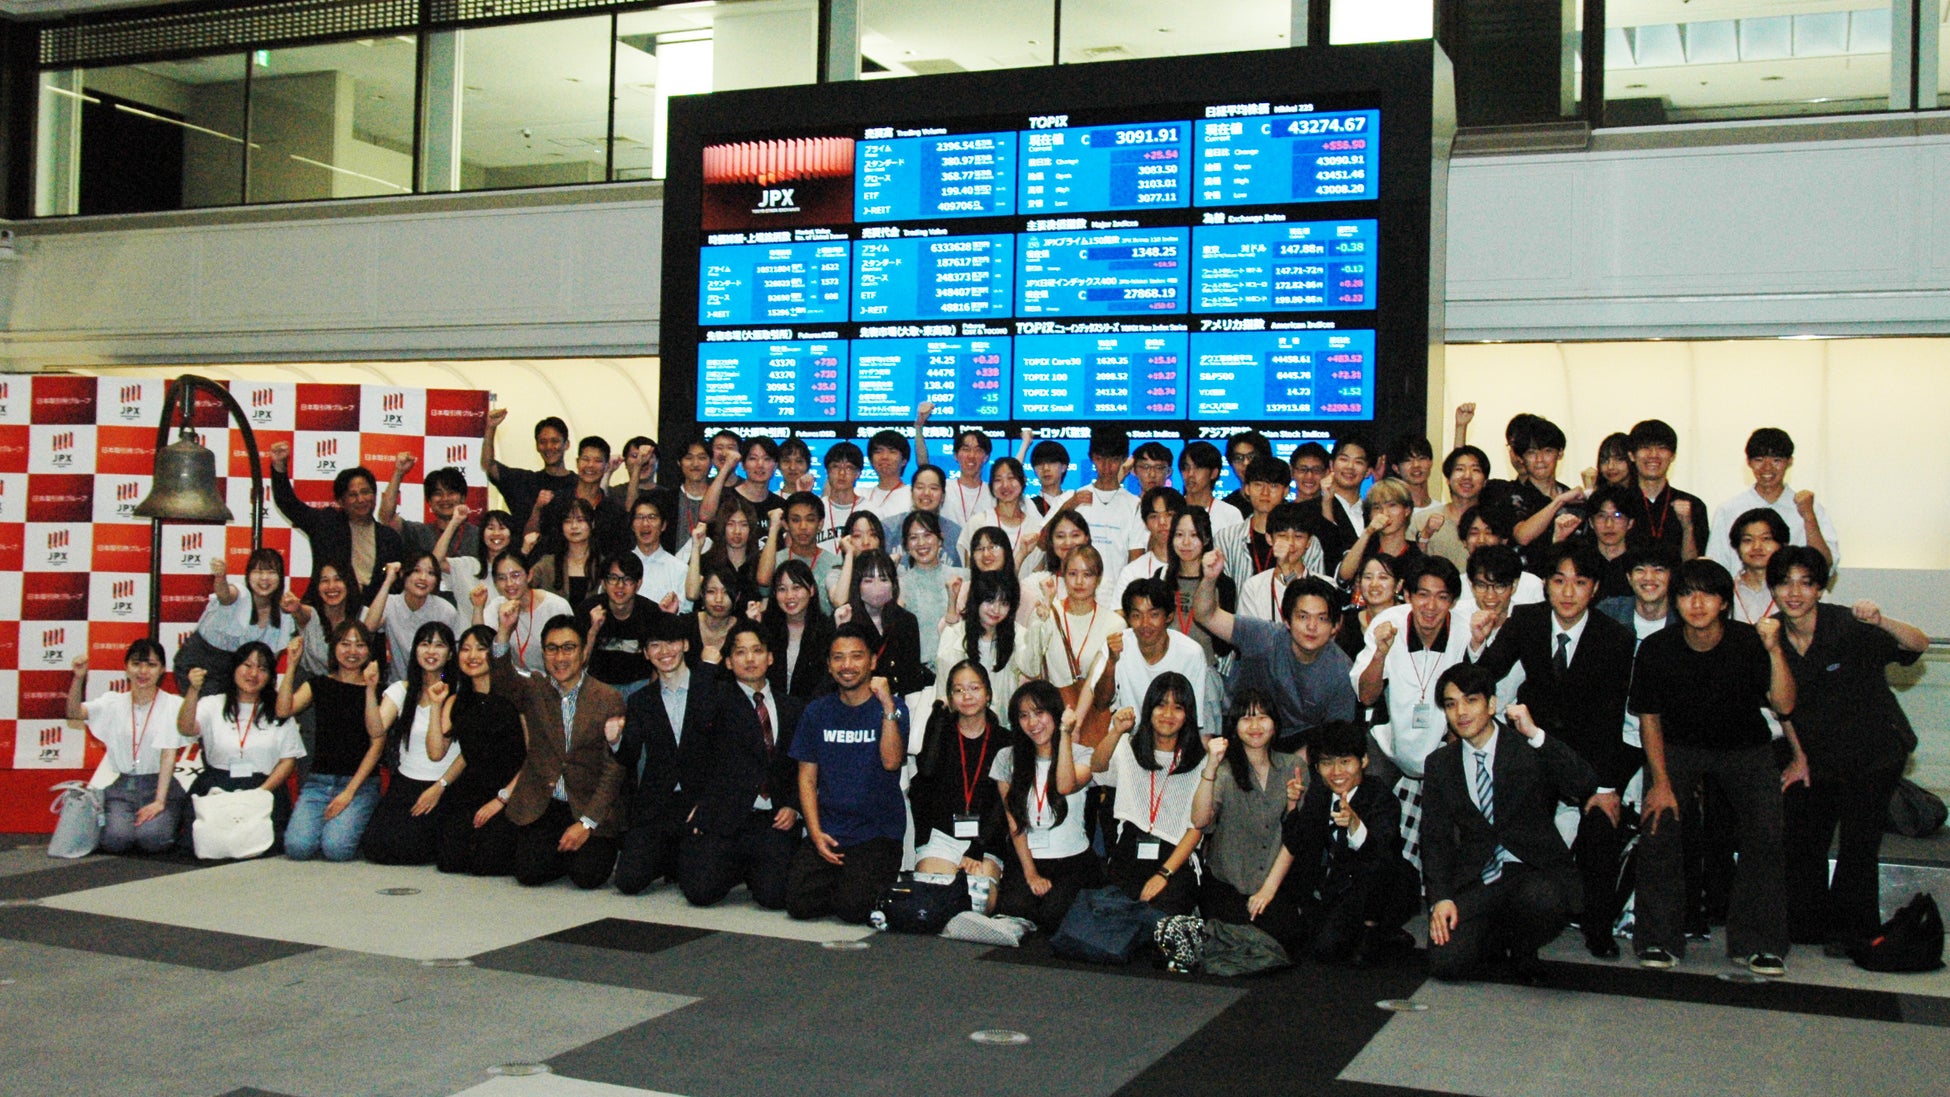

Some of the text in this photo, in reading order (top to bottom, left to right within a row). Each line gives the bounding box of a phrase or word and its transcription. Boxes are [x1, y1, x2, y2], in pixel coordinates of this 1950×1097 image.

[1028, 115, 1068, 129] TOPIX
[1288, 117, 1366, 134] 43274.67
[1261, 124, 1270, 134] C
[1081, 135, 1090, 145] C
[1116, 128, 1178, 144] 3091.91
[1316, 170, 1364, 180] 43451.46
[1138, 179, 1176, 189] 3103.01
[1316, 184, 1364, 194] 43008.20
[758, 188, 794, 208] JPX
[864, 192, 880, 200] ETF
[1138, 193, 1176, 203] 3077.11
[1228, 215, 1263, 223] Exchange
[1336, 243, 1364, 252] -0.38
[1080, 250, 1087, 259] C
[1132, 247, 1176, 258] 1348.25
[1341, 265, 1364, 273] -0.13
[1078, 291, 1086, 300] C
[1124, 288, 1176, 298] 27868.19
[930, 356, 954, 364] 24.25
[1023, 358, 1050, 366] TOPIX
[1338, 388, 1362, 396] -1.52
[982, 394, 998, 402] -15
[976, 406, 998, 414] -650
[1022, 404, 1074, 412] TOPIX Small
[252, 410, 272, 418] JPX
[1132, 430, 1152, 438] Stock
[1280, 430, 1330, 438] Stock Indices
[317, 460, 336, 468] JPX
[48, 552, 68, 560] JPX
[182, 554, 201, 562] JPX
[112, 602, 132, 610] JPX
[823, 729, 876, 744] WEBULL
[174, 767, 204, 776] PX
